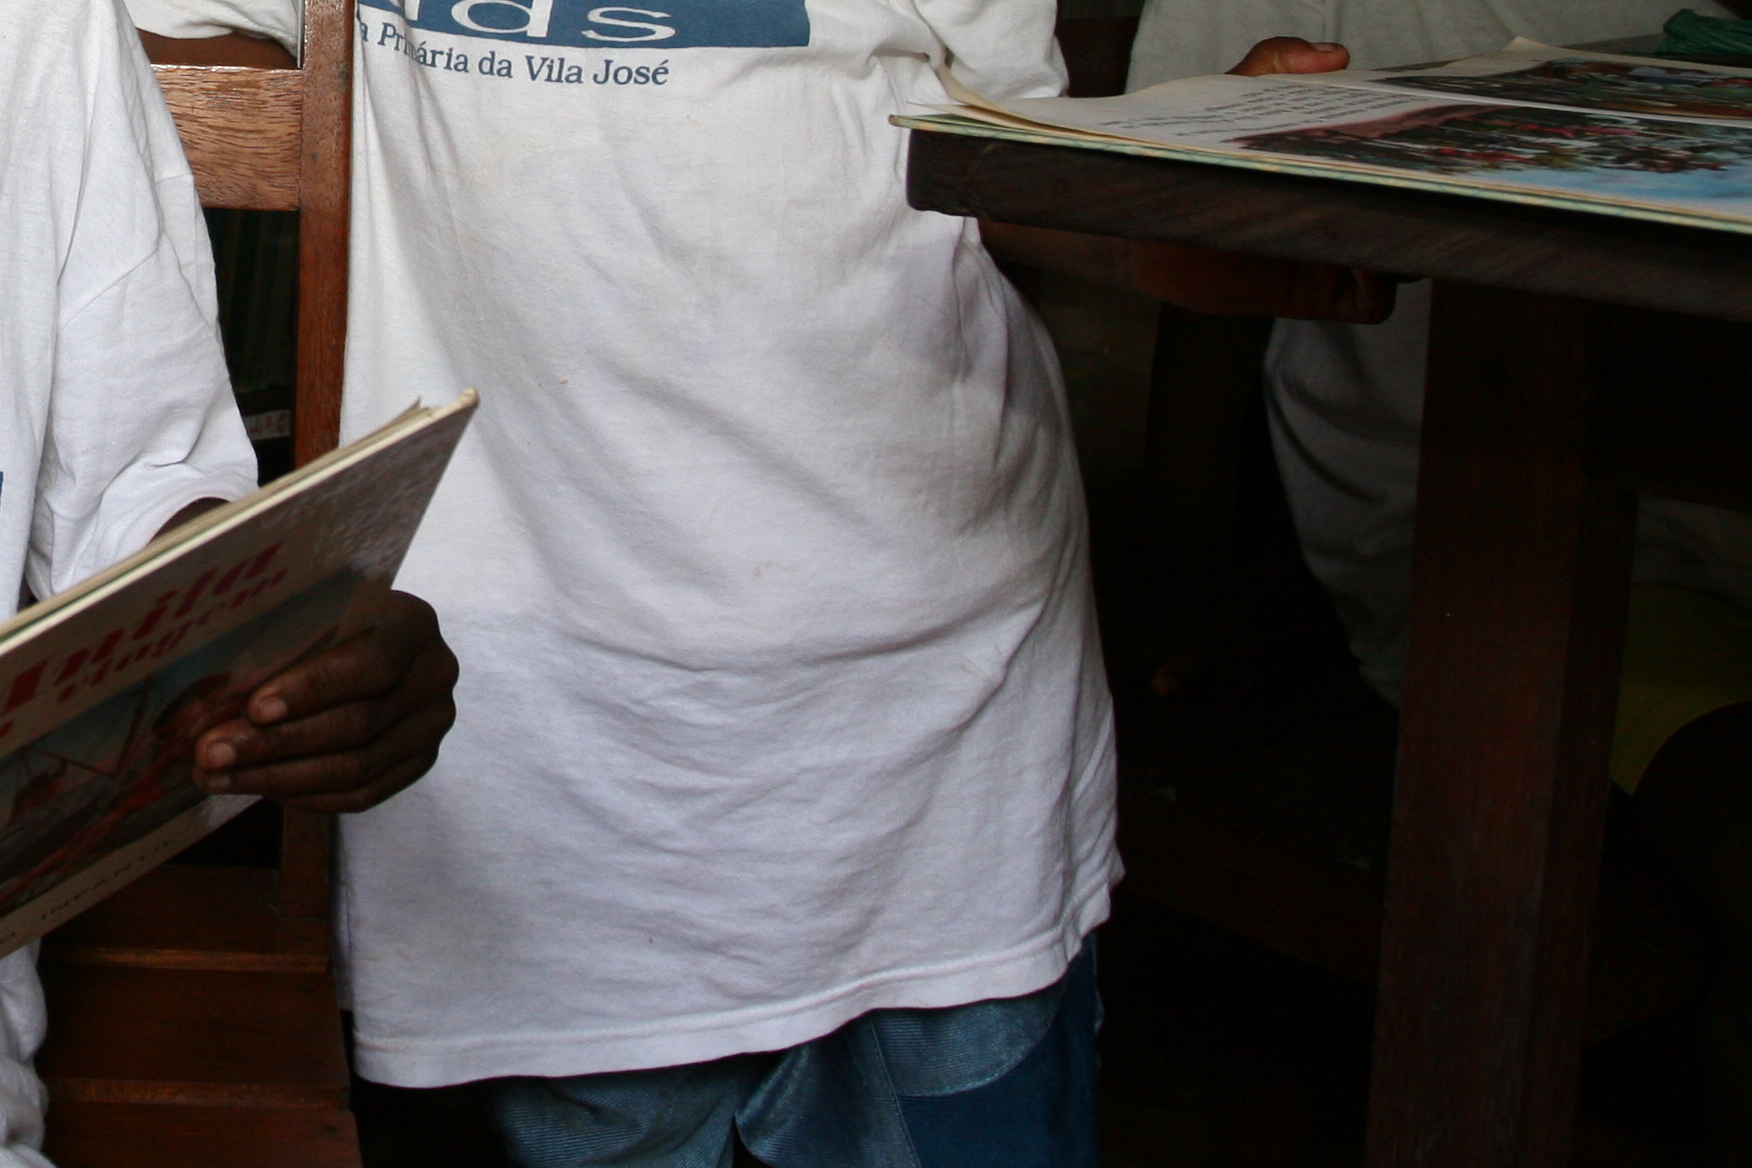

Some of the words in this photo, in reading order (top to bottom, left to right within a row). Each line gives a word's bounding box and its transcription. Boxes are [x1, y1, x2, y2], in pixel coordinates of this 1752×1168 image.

[477, 49, 514, 80] da
[524, 54, 584, 86] Vila
[592, 58, 670, 86] José
